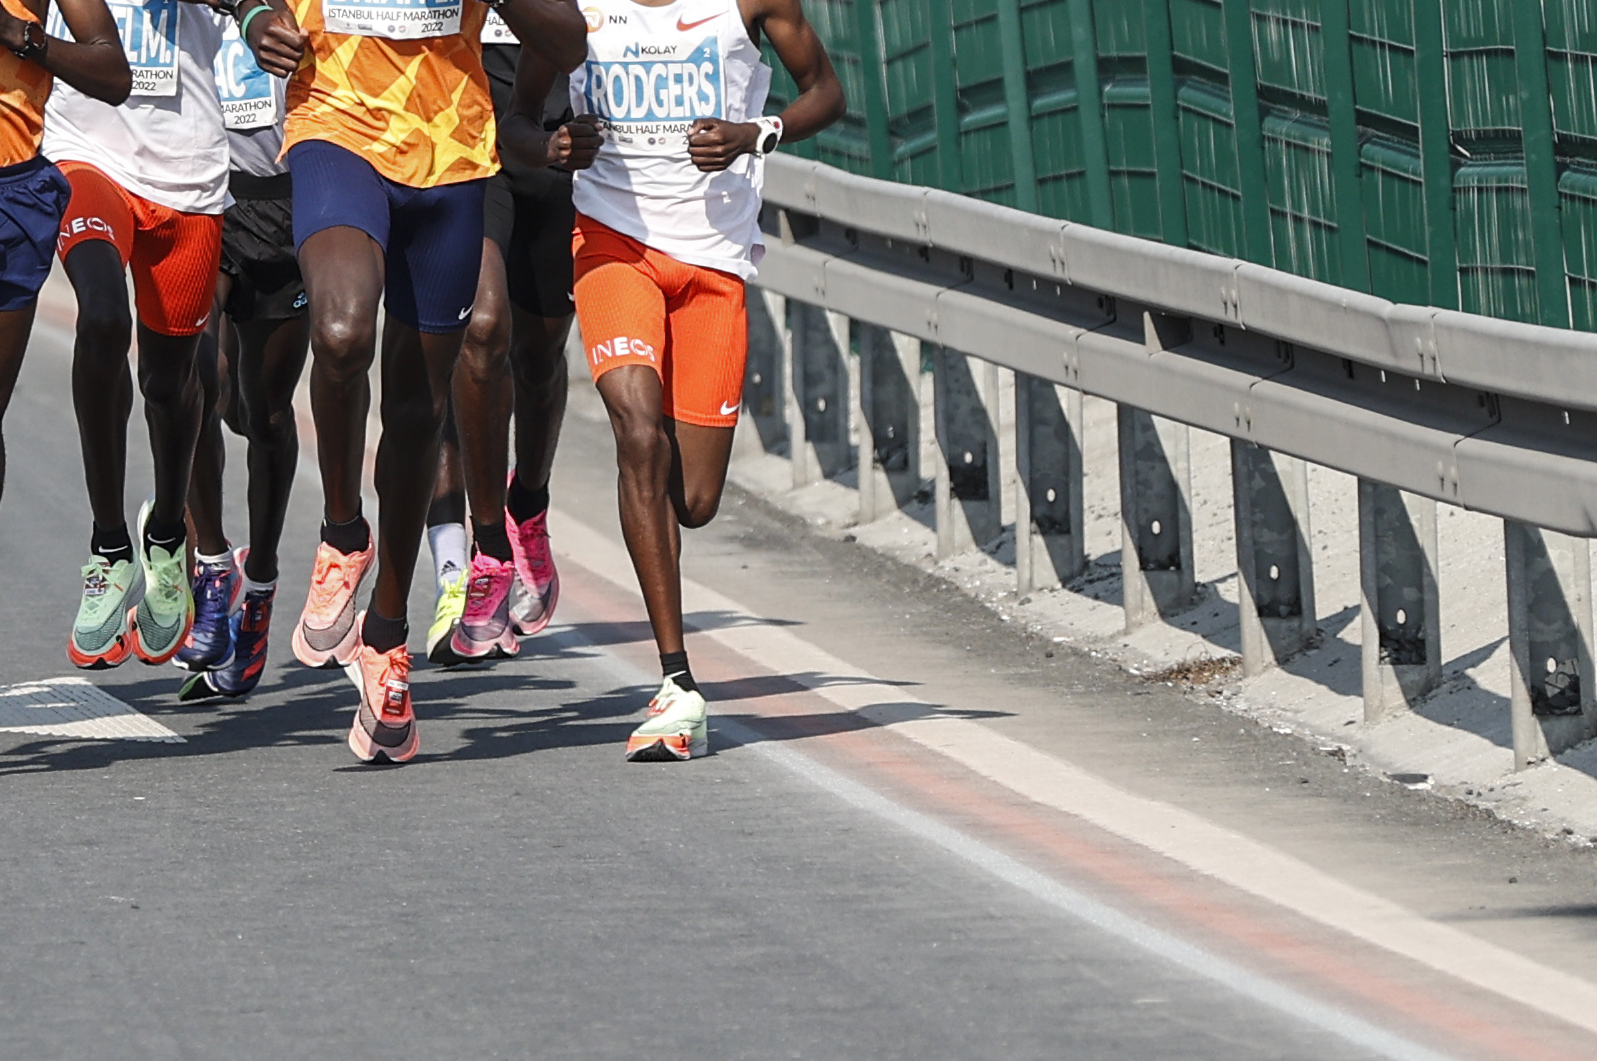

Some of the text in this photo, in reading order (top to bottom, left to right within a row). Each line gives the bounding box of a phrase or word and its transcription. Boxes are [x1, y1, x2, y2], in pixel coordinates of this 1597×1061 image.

[328, 7, 460, 21] ISTANBUL HALF MARATHON
[608, 15, 628, 25] NN
[421, 21, 444, 34] 2022
[641, 45, 677, 55] KOLAY
[703, 47, 711, 58] 2
[132, 69, 174, 80] RATHON
[132, 80, 156, 91] 2022
[590, 61, 716, 120] RODGERS
[221, 99, 272, 114] ARATHON
[234, 113, 257, 125] 2022
[635, 124, 662, 135] HALF
[592, 336, 655, 365] INEOS
